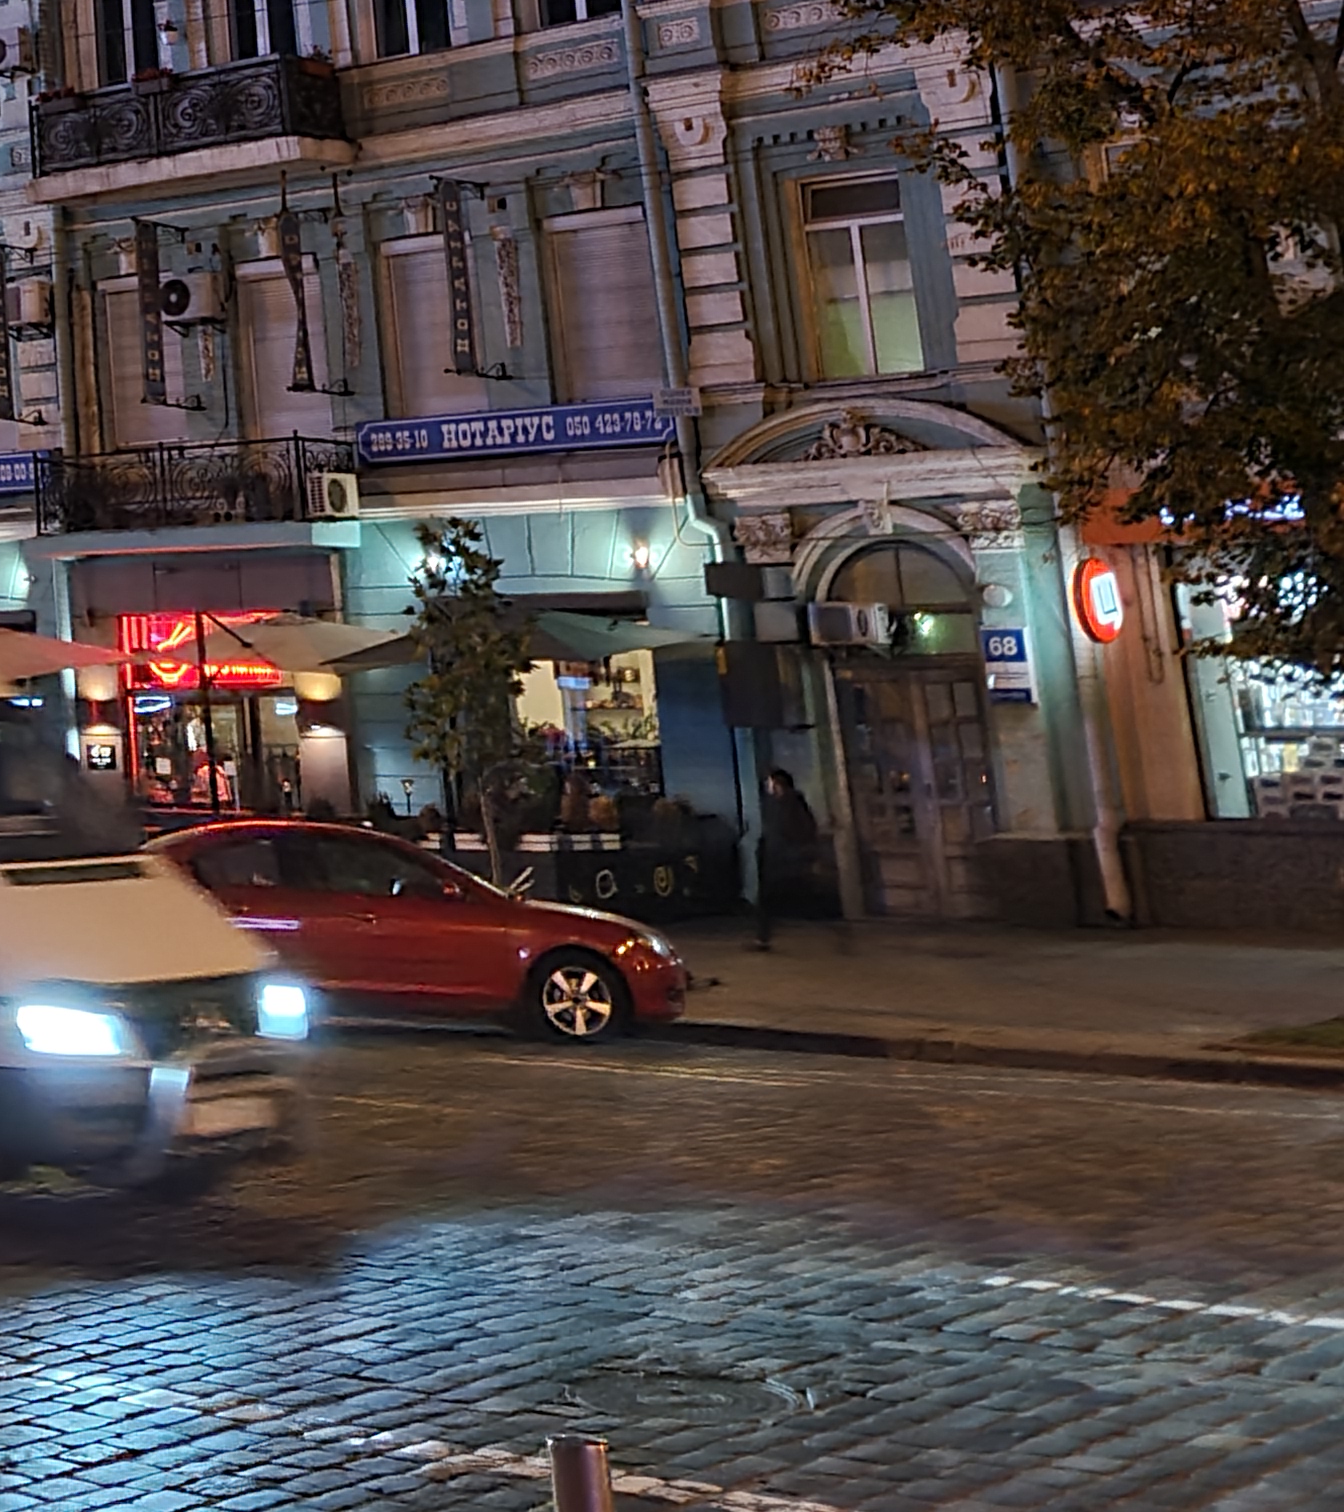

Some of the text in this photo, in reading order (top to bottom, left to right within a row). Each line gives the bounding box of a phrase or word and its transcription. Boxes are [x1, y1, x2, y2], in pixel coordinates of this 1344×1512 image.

[441, 415, 555, 450] НОТАРІУС
[566, 416, 590, 436] 050
[988, 635, 1018, 657] 68
